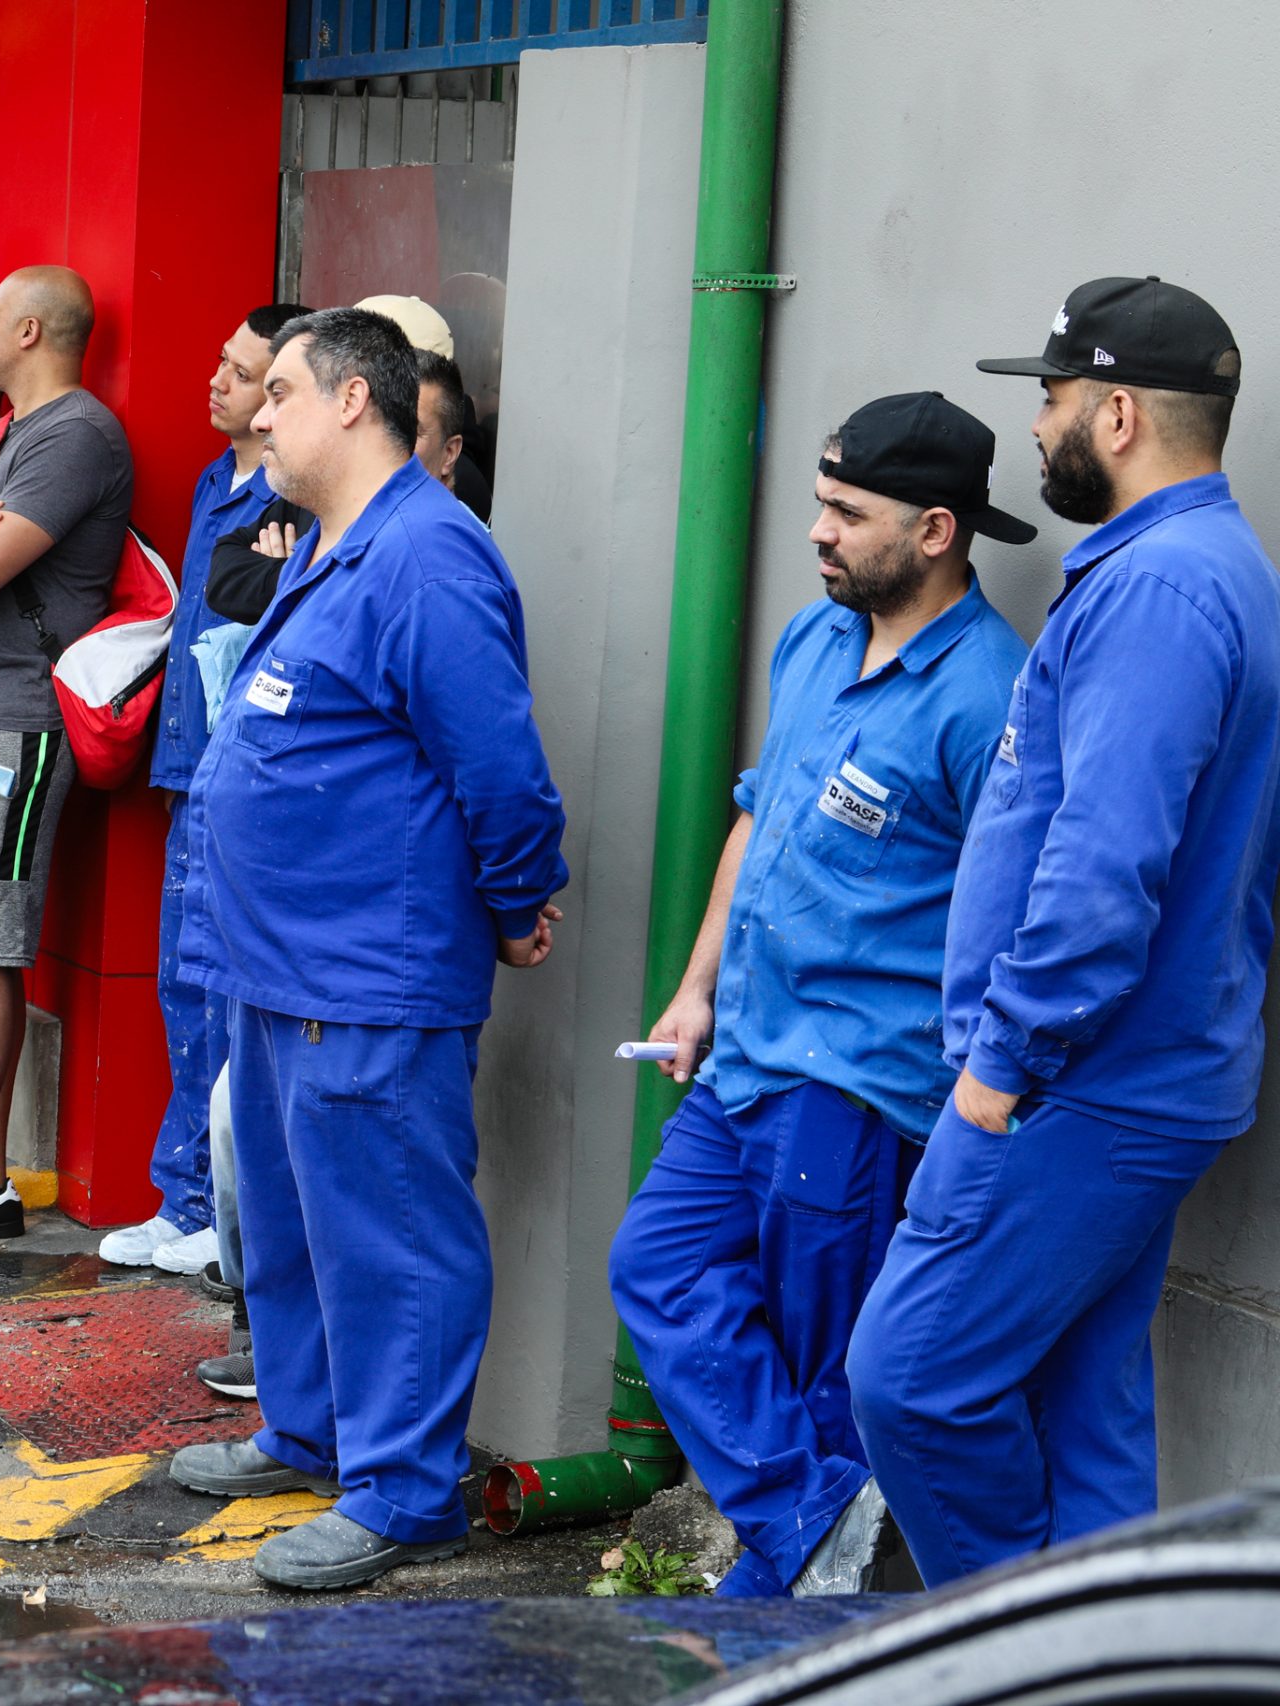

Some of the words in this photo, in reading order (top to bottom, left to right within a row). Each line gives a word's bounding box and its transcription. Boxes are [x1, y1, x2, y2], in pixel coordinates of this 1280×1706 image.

[262, 682, 289, 698] BASF
[847, 770, 879, 795] LEANDRO
[842, 796, 881, 823] BASF
